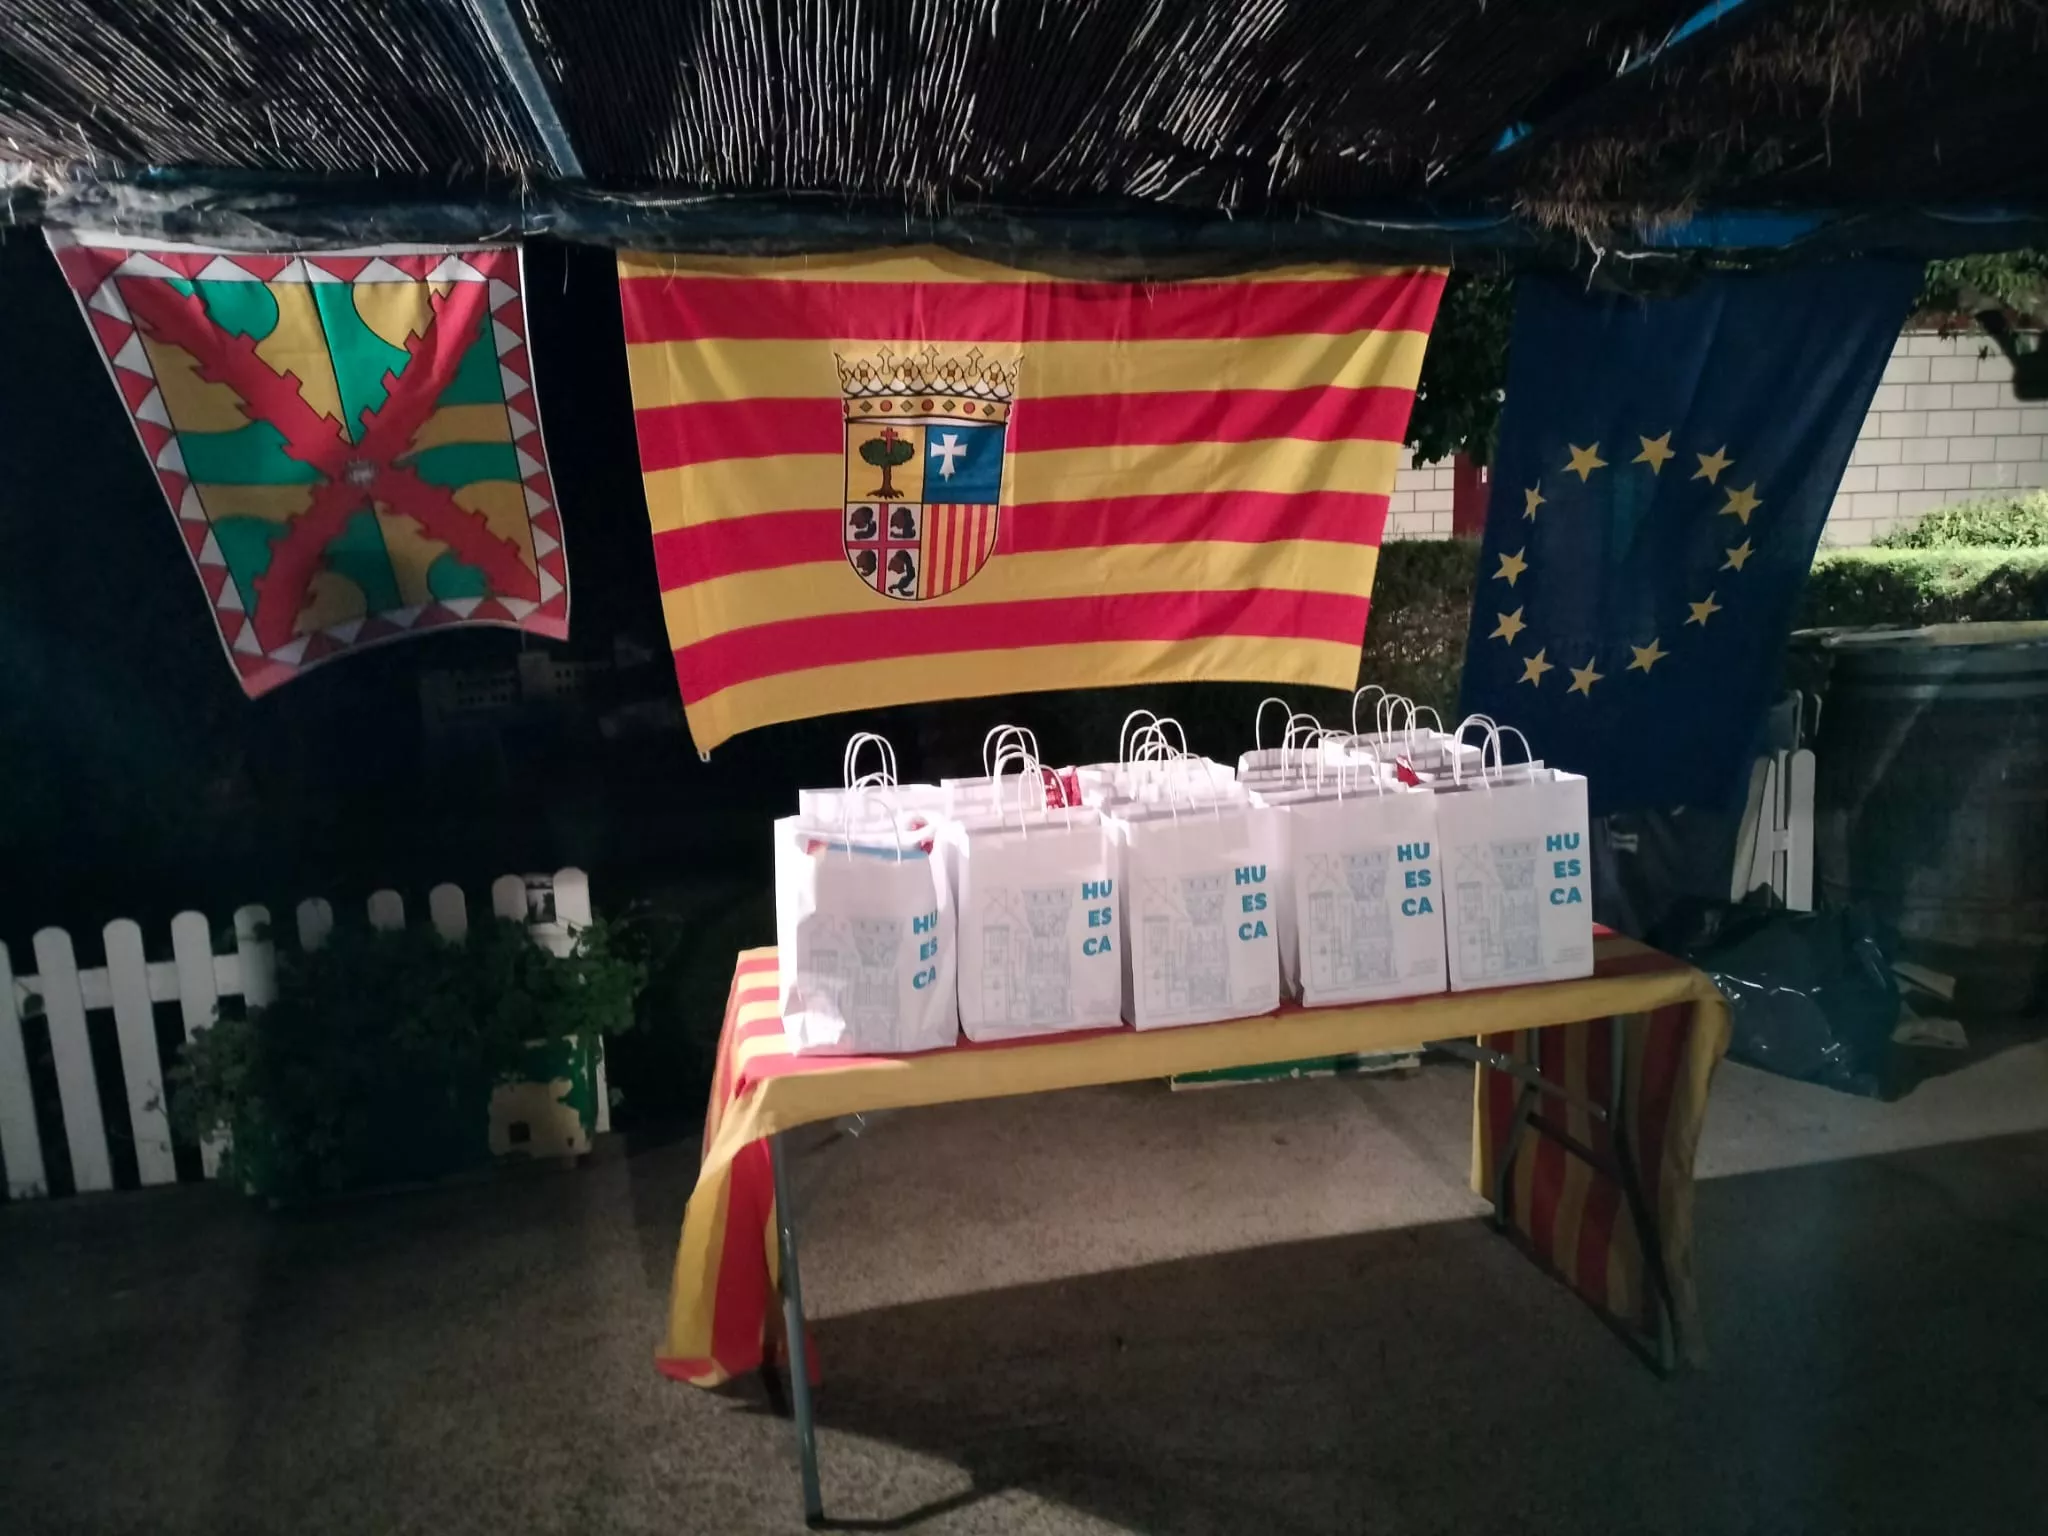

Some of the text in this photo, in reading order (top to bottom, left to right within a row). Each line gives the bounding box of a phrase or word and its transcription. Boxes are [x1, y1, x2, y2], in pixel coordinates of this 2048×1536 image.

[1397, 842, 1430, 863] HU
[1546, 832, 1580, 853] HU
[1235, 864, 1266, 886] HU
[1405, 869, 1432, 889] ES
[1553, 858, 1582, 879] ES
[1082, 879, 1113, 900] HU
[1549, 885, 1582, 906] CA
[1242, 892, 1267, 913] ES
[1401, 896, 1434, 917] CA
[913, 910, 938, 935] HU
[1088, 906, 1112, 928] ES
[1238, 920, 1268, 941] CA
[920, 936, 938, 962] ES
[1082, 934, 1112, 956] CA
[912, 966, 937, 990] CA
